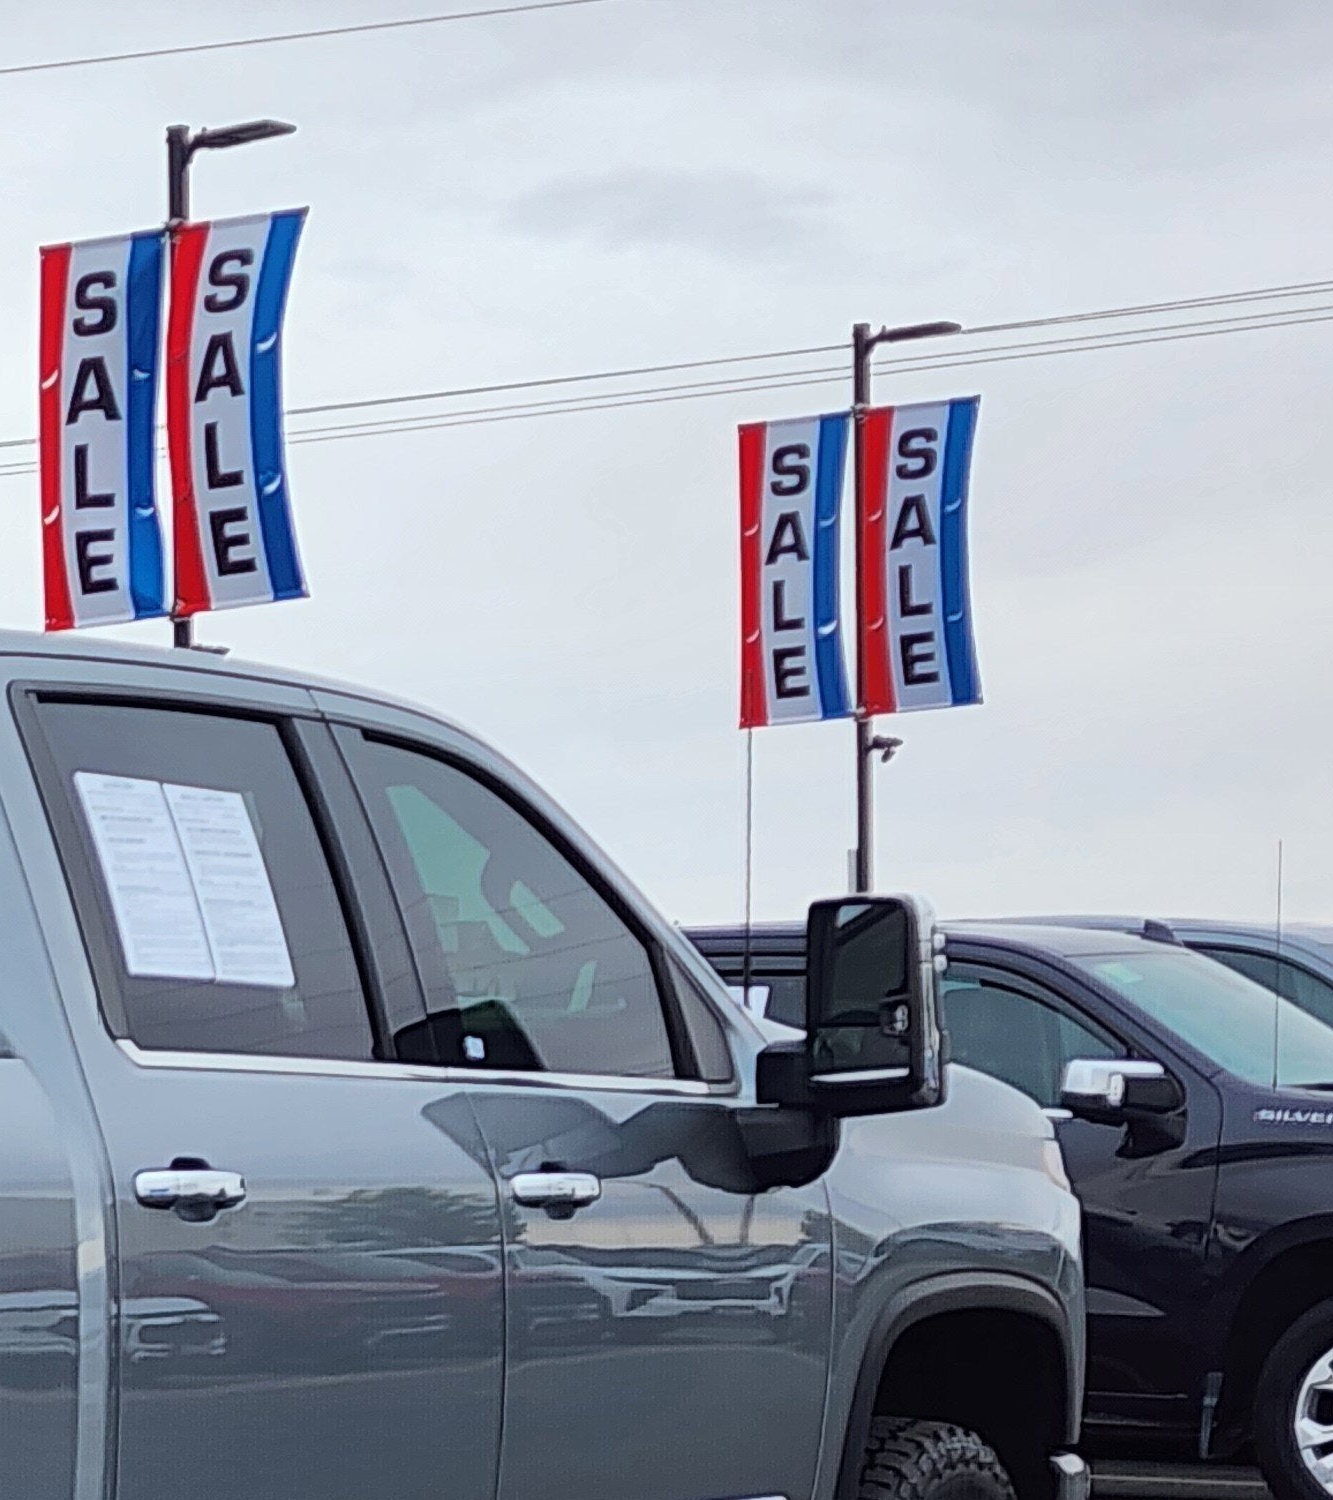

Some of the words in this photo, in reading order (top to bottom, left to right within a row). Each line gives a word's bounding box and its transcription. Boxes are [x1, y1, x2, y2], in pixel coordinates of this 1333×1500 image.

[65, 270, 122, 596] SALE
[194, 248, 258, 576] SALE
[889, 427, 940, 687] SALE
[764, 443, 811, 700] SALE
